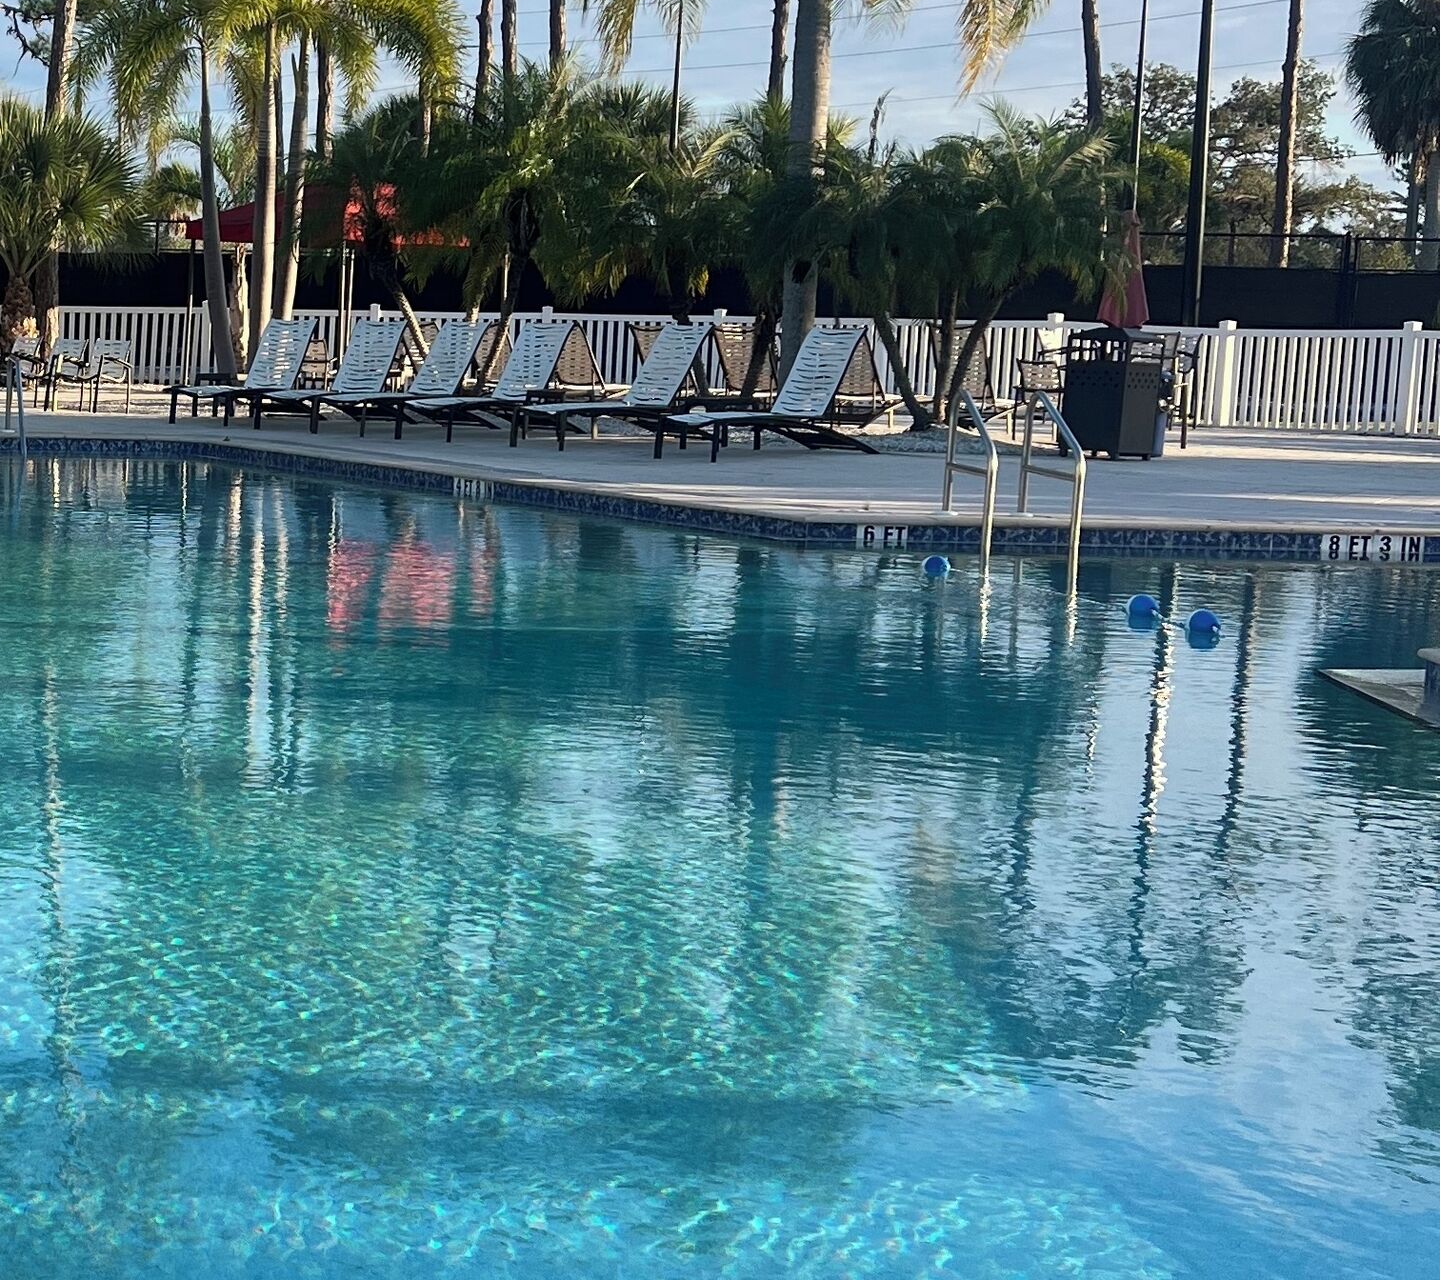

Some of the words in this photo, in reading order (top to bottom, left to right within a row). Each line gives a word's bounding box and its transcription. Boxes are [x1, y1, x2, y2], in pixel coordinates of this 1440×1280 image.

[863, 525, 876, 544] 6
[883, 526, 907, 544] FT
[1329, 535, 1340, 554] 8
[1348, 535, 1372, 554] FT
[1379, 535, 1392, 554] 3
[1401, 536, 1421, 556] IN
